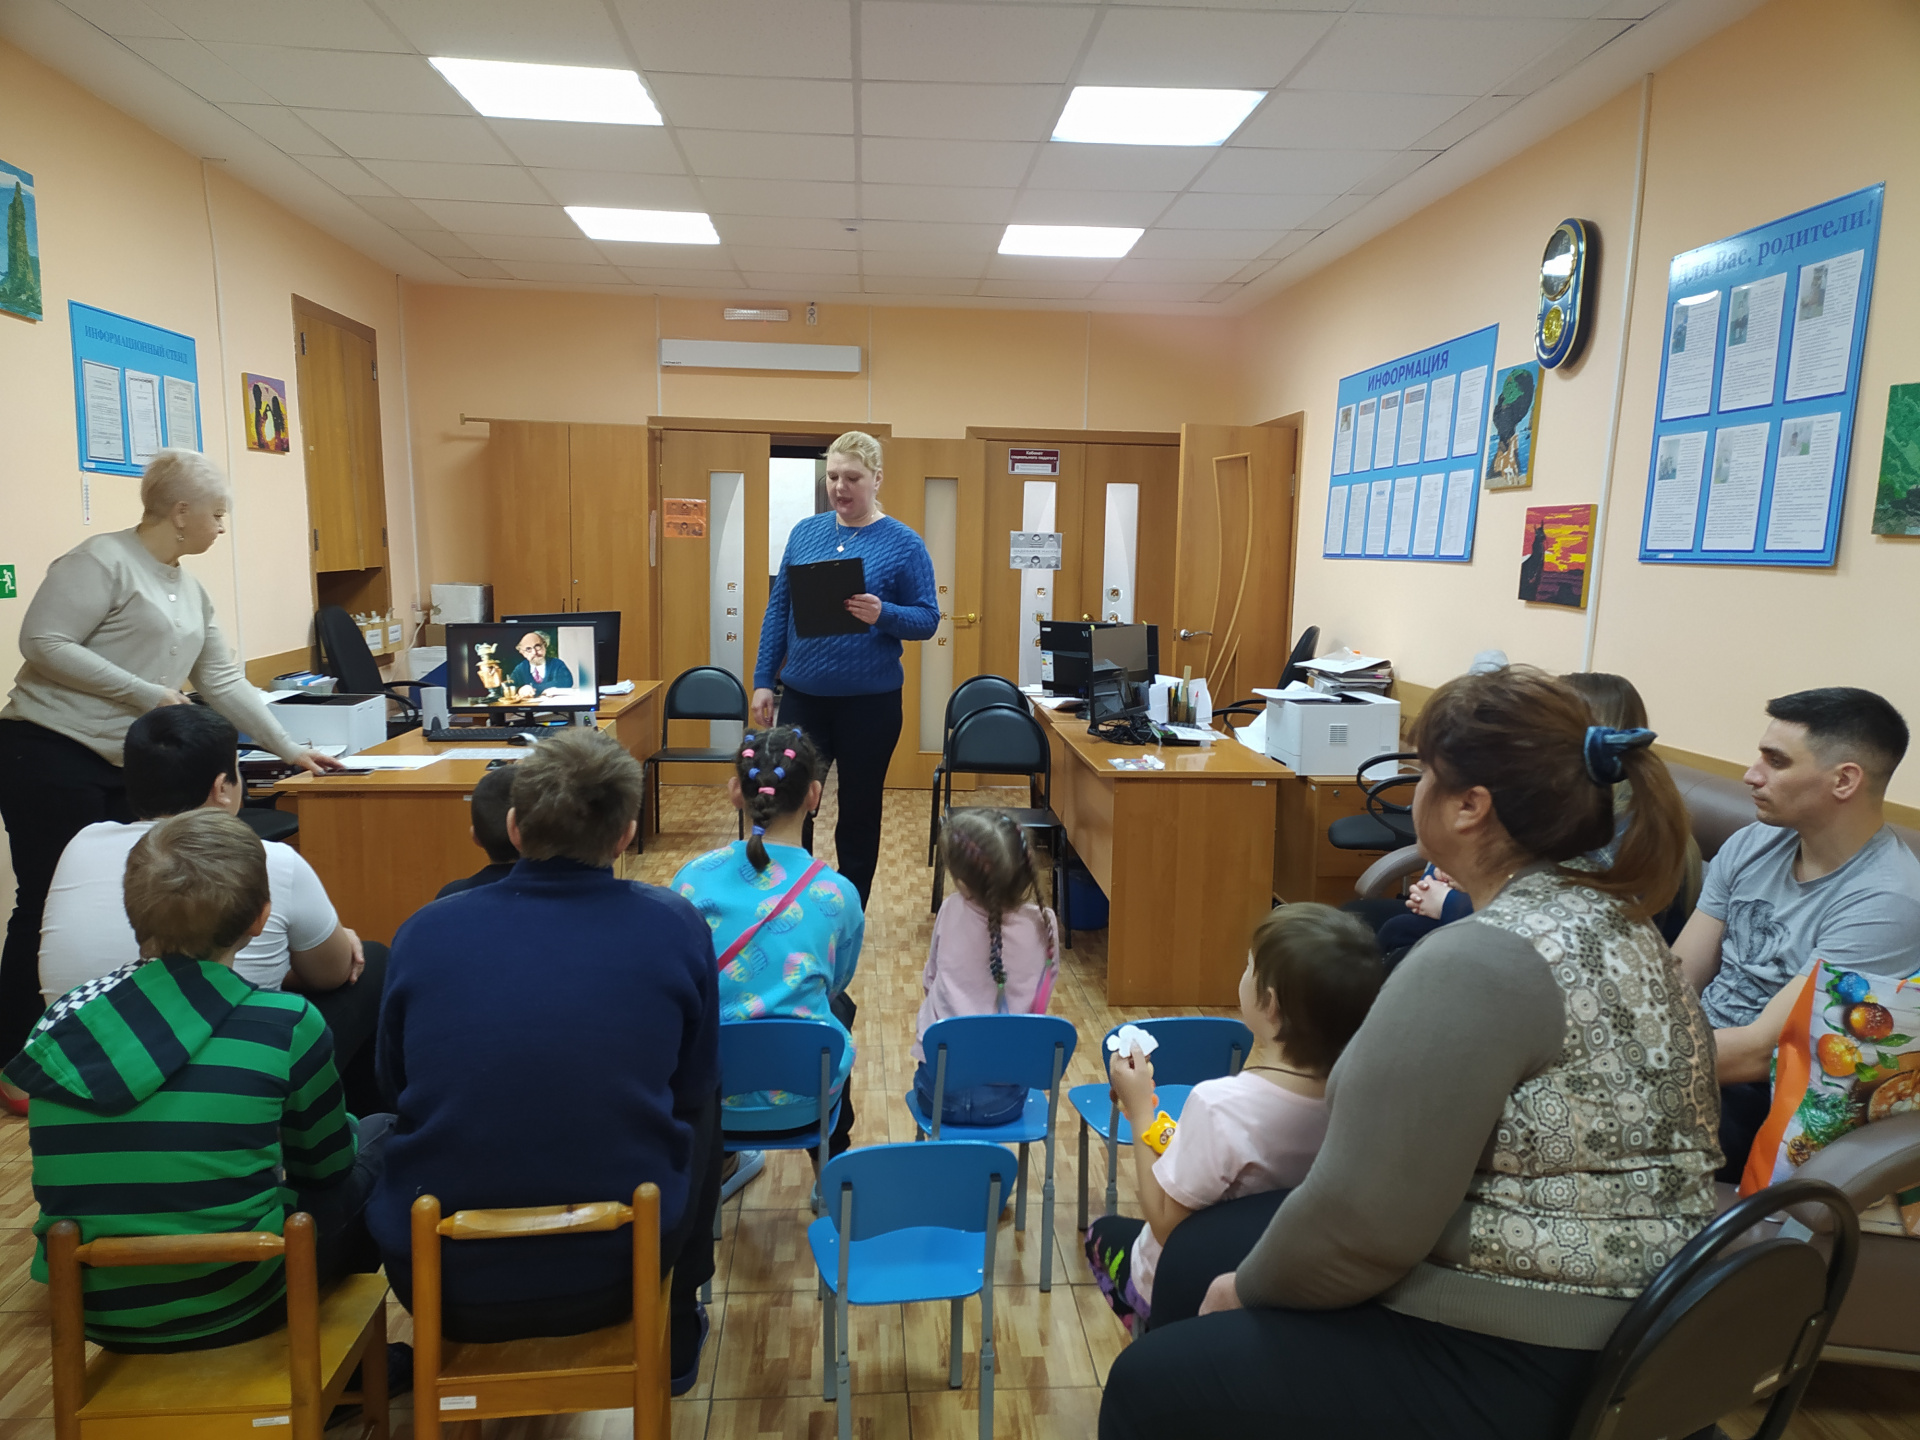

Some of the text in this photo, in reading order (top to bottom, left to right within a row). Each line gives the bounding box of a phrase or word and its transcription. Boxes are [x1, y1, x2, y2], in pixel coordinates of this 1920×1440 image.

[1756, 200, 1875, 266] родители!
[84, 325, 188, 364] ИНФОРМАЦИОННЫЙ СТЕНД
[1367, 349, 1449, 392] ИНФОРМАЦИЯ
